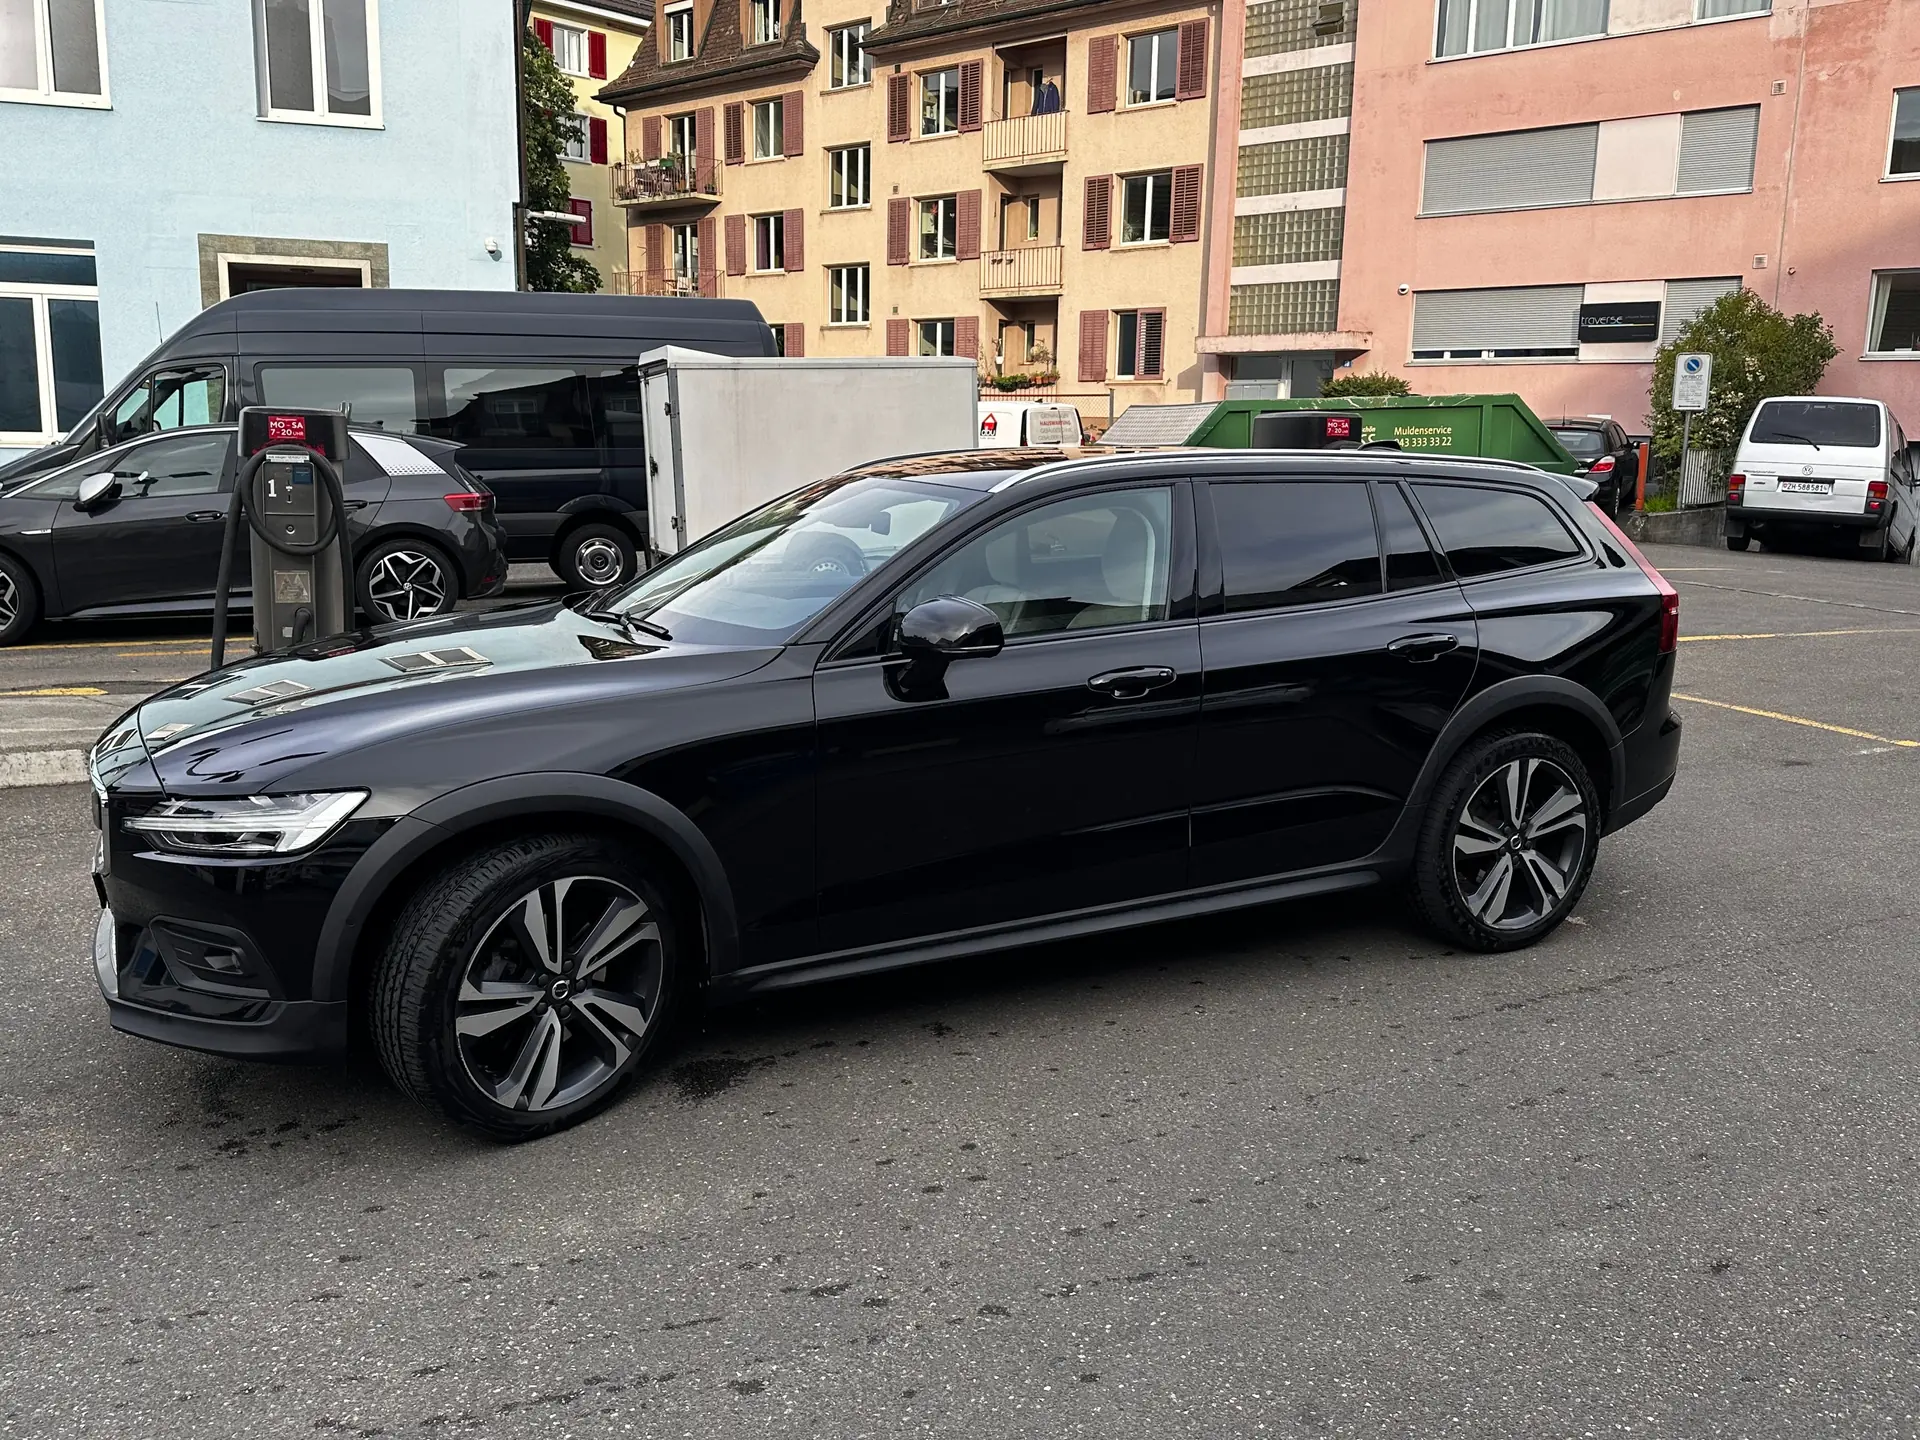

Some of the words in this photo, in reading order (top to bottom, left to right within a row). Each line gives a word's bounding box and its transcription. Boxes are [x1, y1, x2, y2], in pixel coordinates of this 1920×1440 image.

[1581, 315, 1623, 325] traverse
[270, 421, 285, 429] MO
[291, 421, 304, 429] SA
[1394, 426, 1452, 435] Muldenservice
[1411, 437, 1427, 447] 333
[1429, 436, 1441, 447] 33
[1441, 436, 1452, 446] 22
[268, 479, 277, 497] 1
